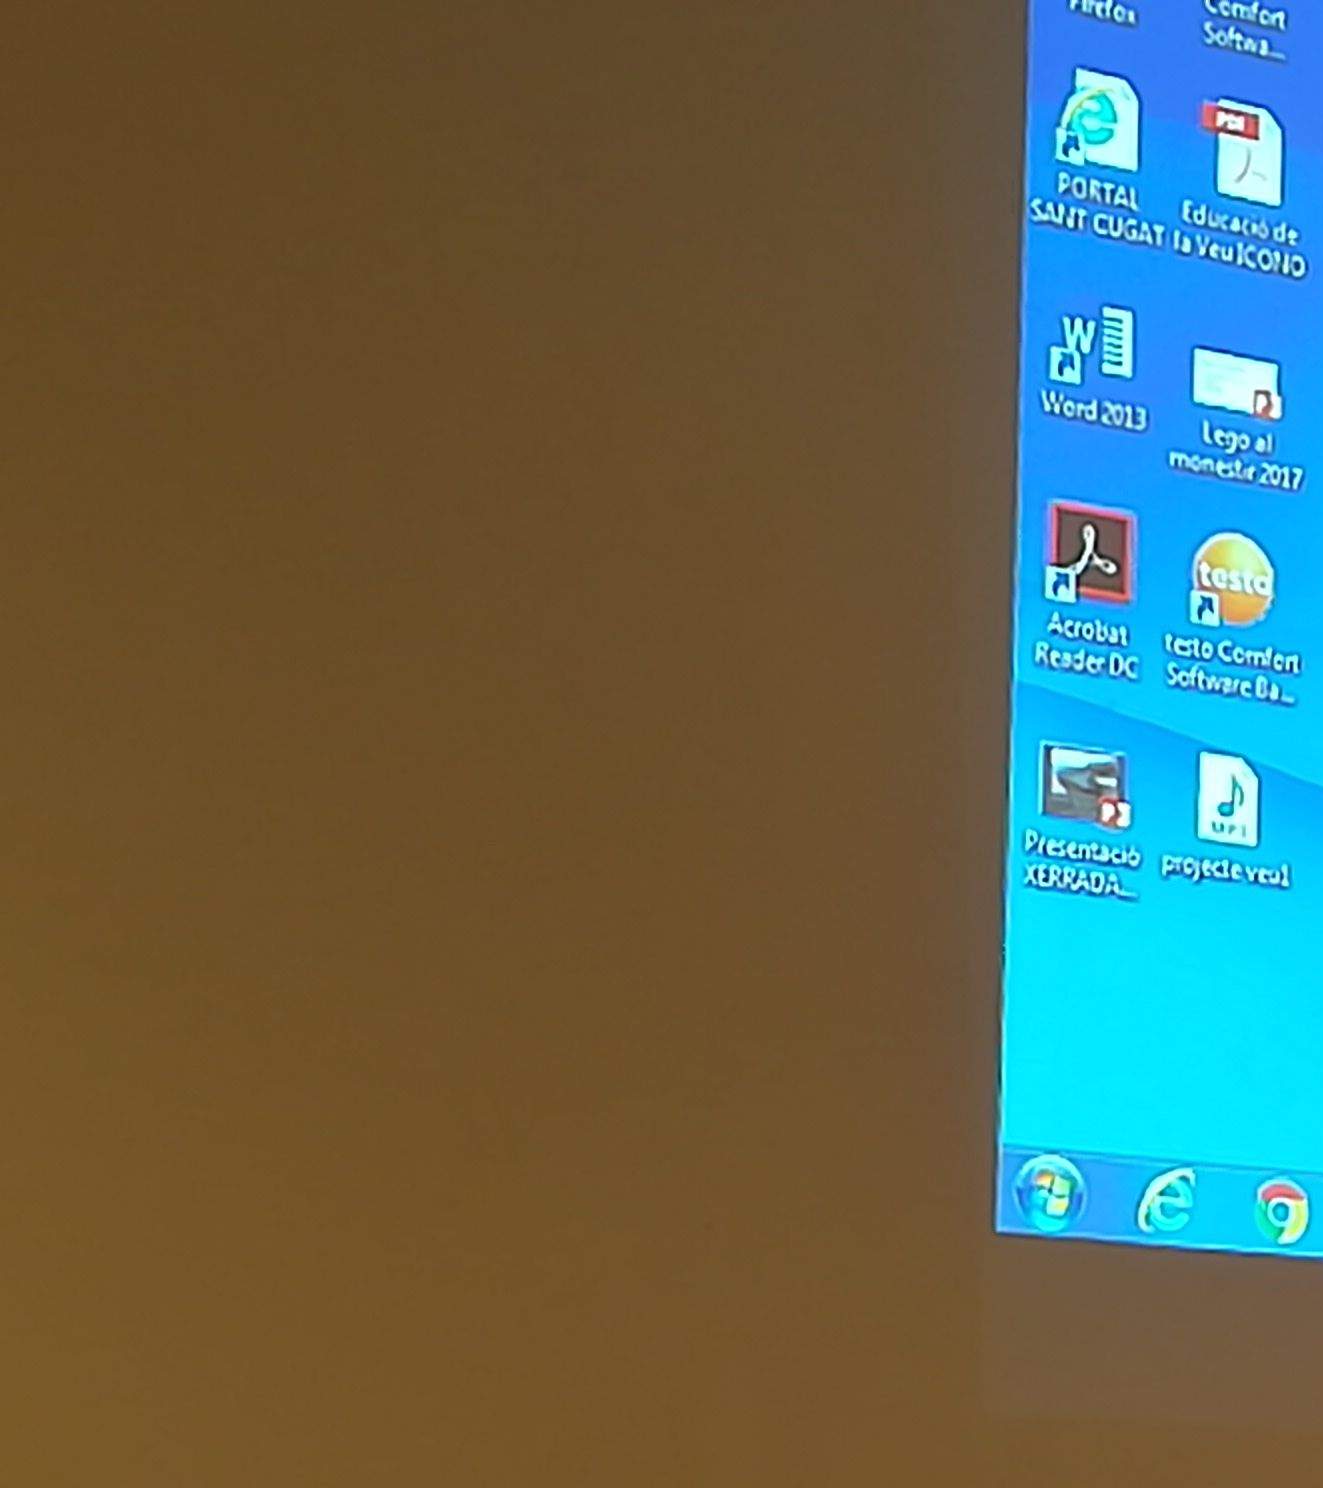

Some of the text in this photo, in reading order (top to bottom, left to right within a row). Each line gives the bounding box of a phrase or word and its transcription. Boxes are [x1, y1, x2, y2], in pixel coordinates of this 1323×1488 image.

[1057, 172, 1138, 211] PORTAL
[1030, 197, 1164, 247] SANT CUGAT
[1181, 199, 1299, 246] Educació de
[1173, 229, 1307, 278] la Veu ICONO
[1042, 390, 1147, 430] Word 2013
[1203, 420, 1272, 453] Lego al
[1169, 452, 1302, 490] monestir 2017
[1199, 561, 1273, 596] testo
[1048, 612, 1128, 646] Acrobat
[1034, 641, 1139, 678] Reader DC
[1164, 634, 1301, 673] testo Comfort
[1167, 662, 1251, 699] Software
[1025, 829, 1141, 866] Presentació
[1161, 853, 1241, 883] projecte
